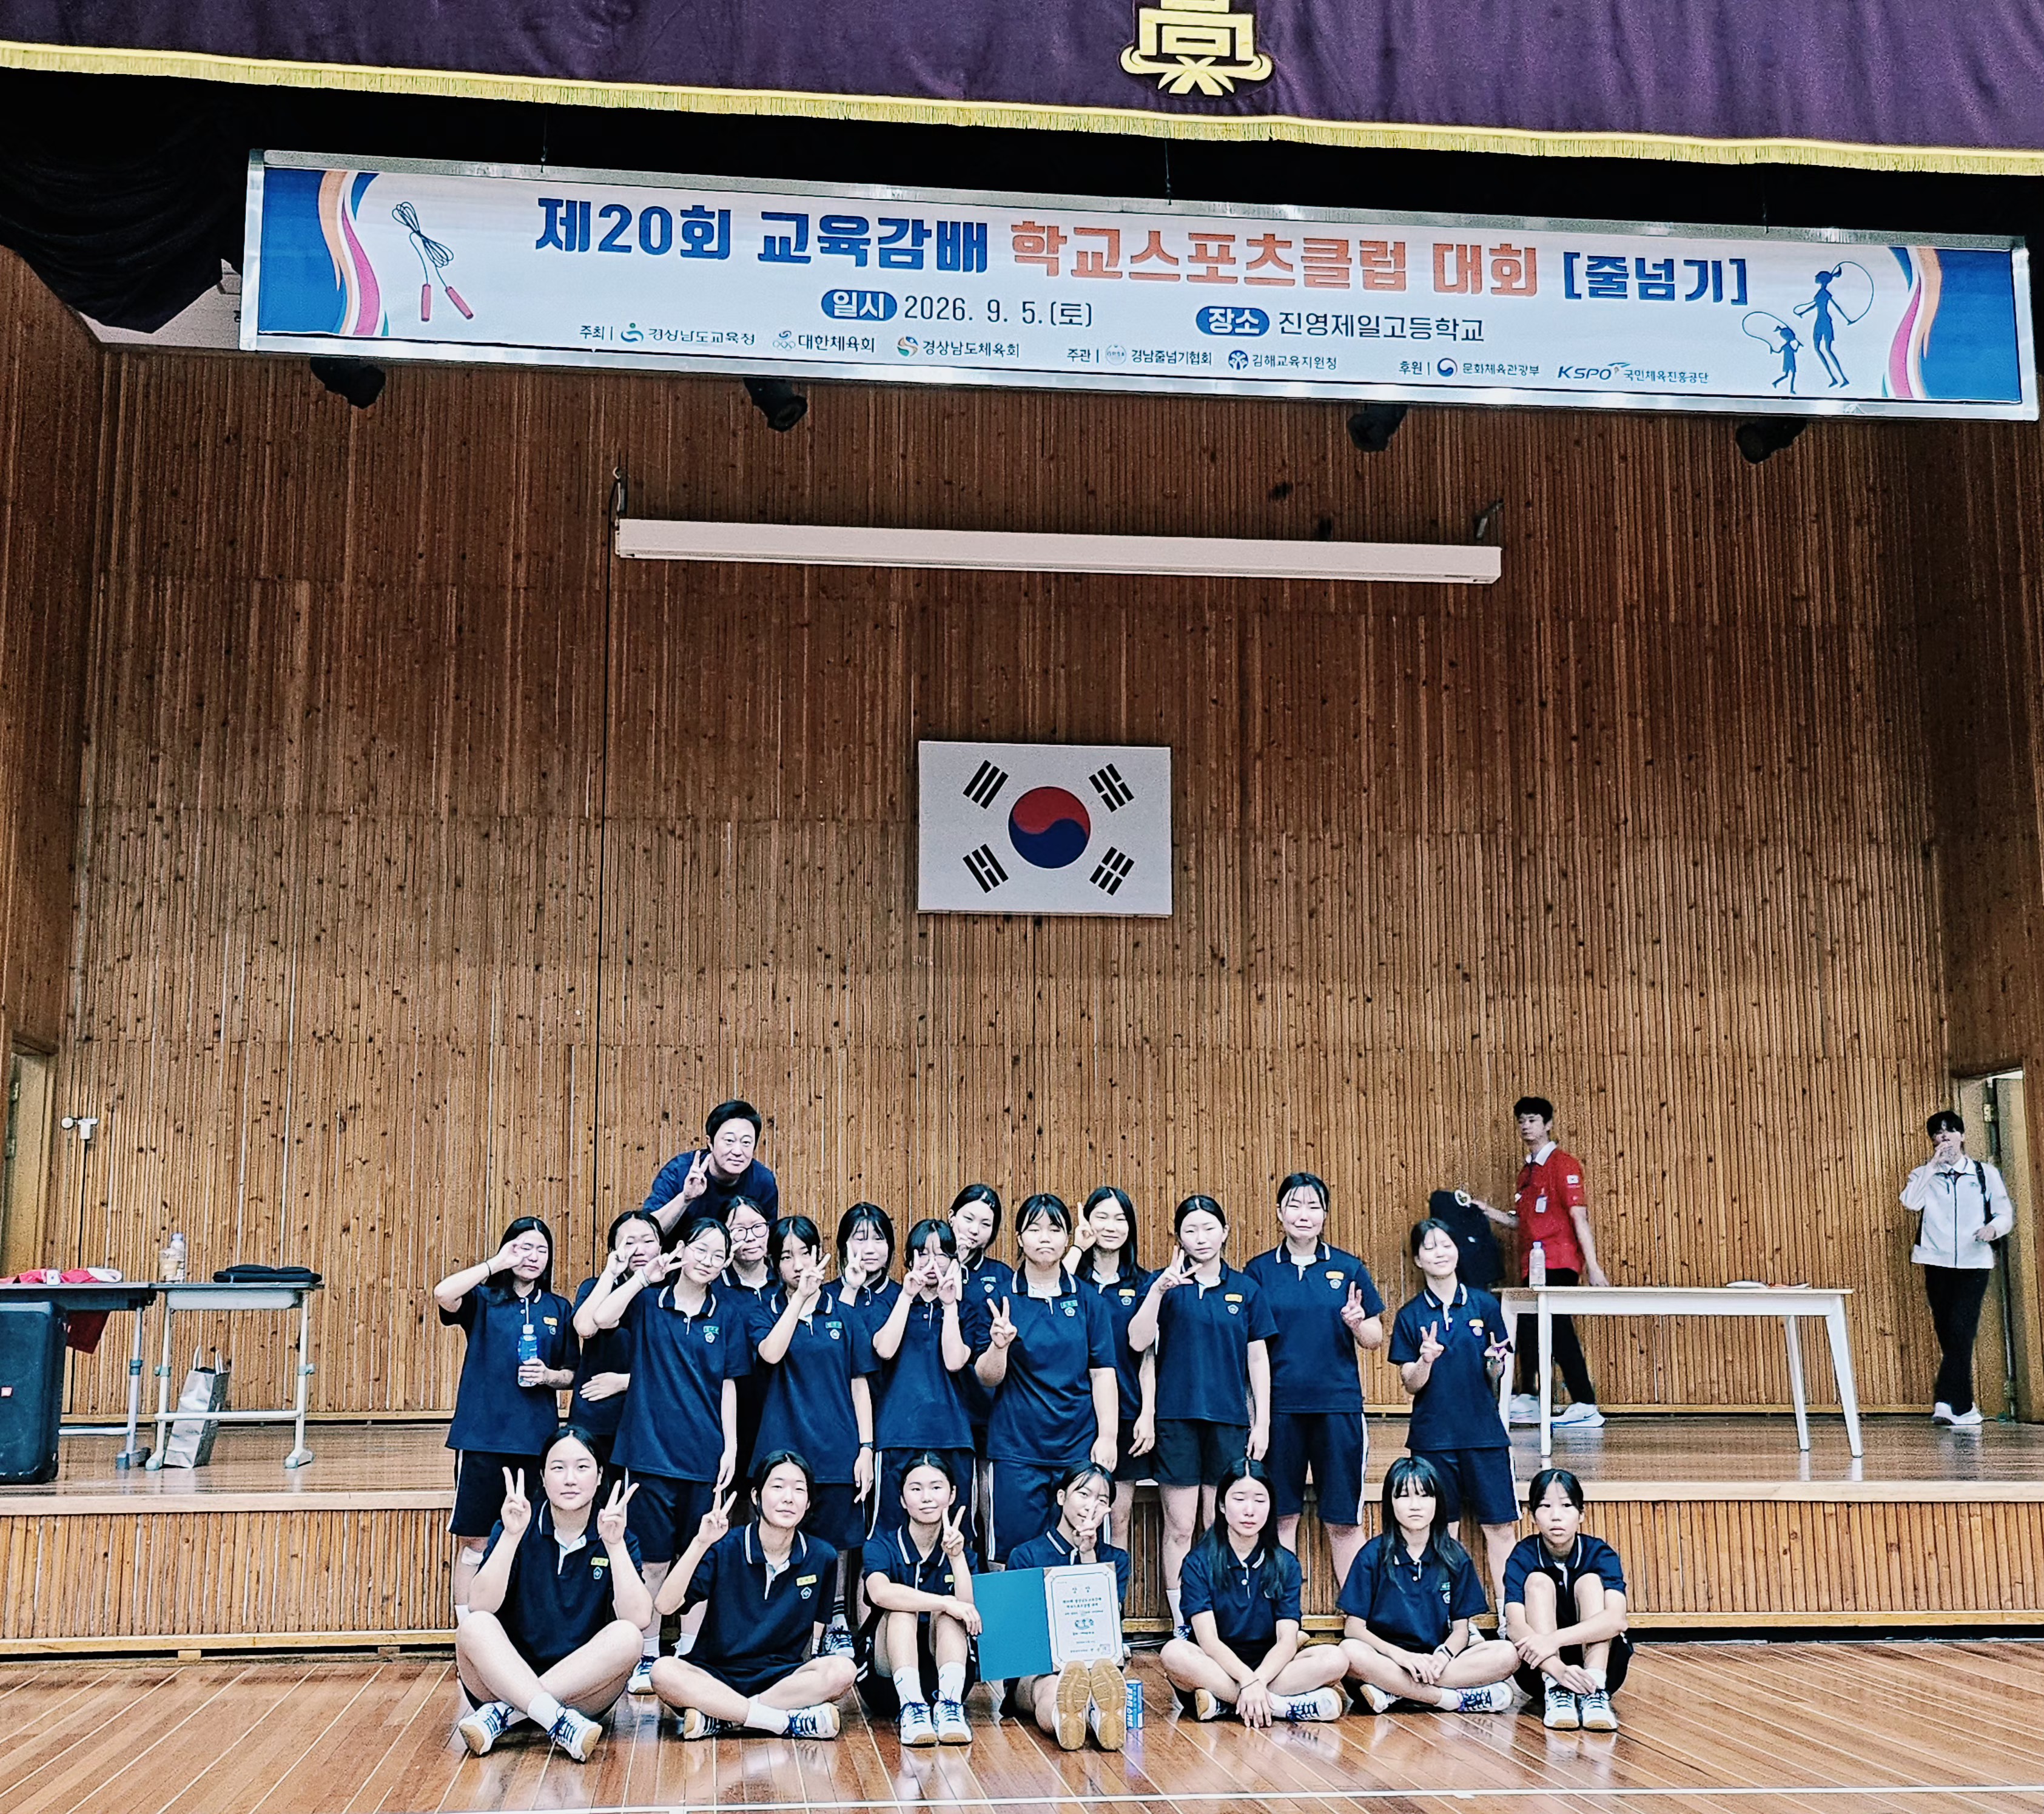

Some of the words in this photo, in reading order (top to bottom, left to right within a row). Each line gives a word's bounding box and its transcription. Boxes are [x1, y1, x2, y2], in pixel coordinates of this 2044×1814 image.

[535, 197, 731, 260] 제20회
[756, 211, 988, 274] 교육감배
[1010, 220, 1407, 292] 학교스포츠클럽
[1432, 243, 1538, 297] 대회
[1562, 251, 1749, 306] [줄넘기]
[832, 291, 886, 319] 일시
[904, 295, 973, 322] 2026.
[987, 298, 1009, 323] 9.
[1021, 300, 1092, 328] 5.(토)
[1208, 308, 1261, 335] 장소
[1278, 312, 1485, 342] 진영제일고등학교
[579, 325, 605, 340] 주최
[648, 328, 756, 346] 경상남도교육청
[798, 334, 875, 353] 대한체육회
[923, 340, 1020, 358] 경상남도체육회
[1066, 348, 1091, 363] 주관
[1131, 349, 1212, 366] 경남줄넘기협회
[1252, 354, 1337, 370] 김해교육지원청
[1398, 361, 1423, 375] 후원
[1462, 363, 1540, 376] 문화체육관광부
[1557, 366, 1612, 380] KSPO
[1623, 369, 1710, 384] 국민체육진흥공단
